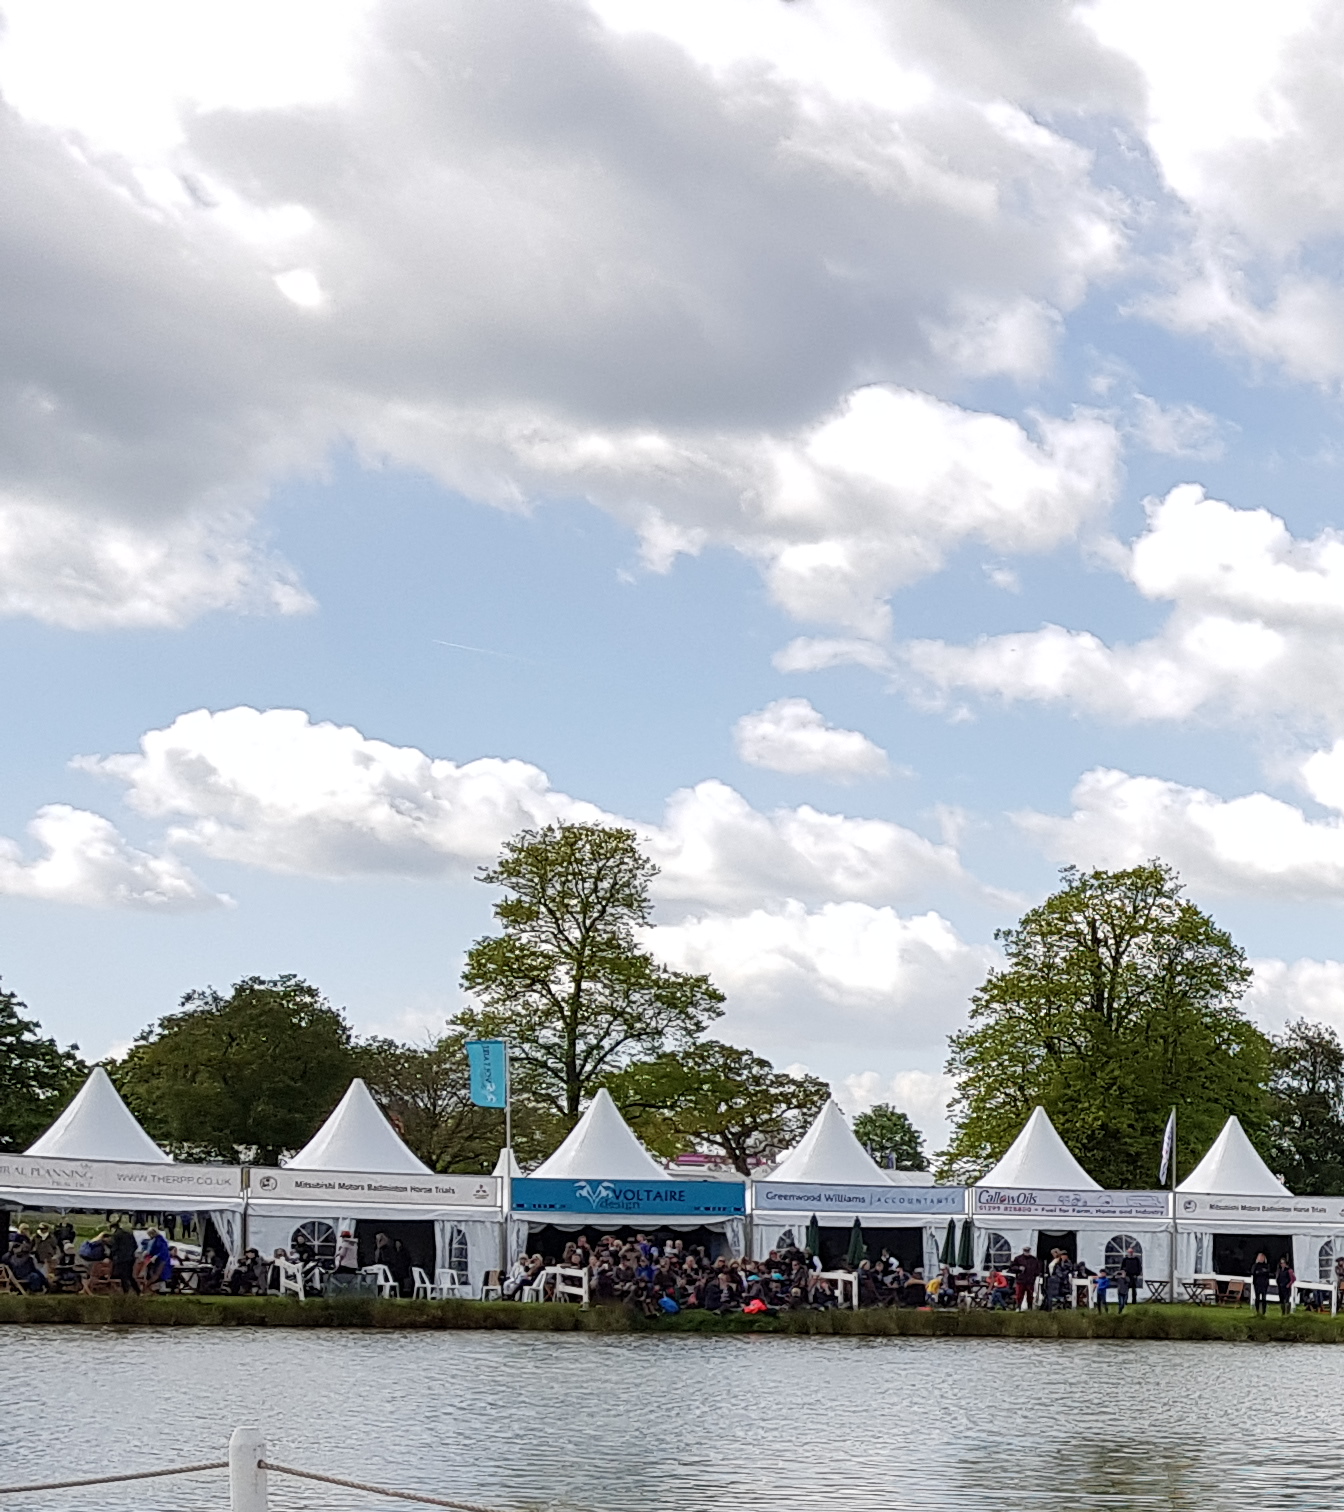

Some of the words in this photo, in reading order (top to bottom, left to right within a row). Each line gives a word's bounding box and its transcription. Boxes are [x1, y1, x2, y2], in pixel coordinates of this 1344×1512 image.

[613, 1189, 686, 1202] VOLTAIRE
[765, 1191, 821, 1202] Greenwood
[824, 1193, 866, 1204] Williams
[876, 1197, 956, 1205] ACCOUNTANTS
